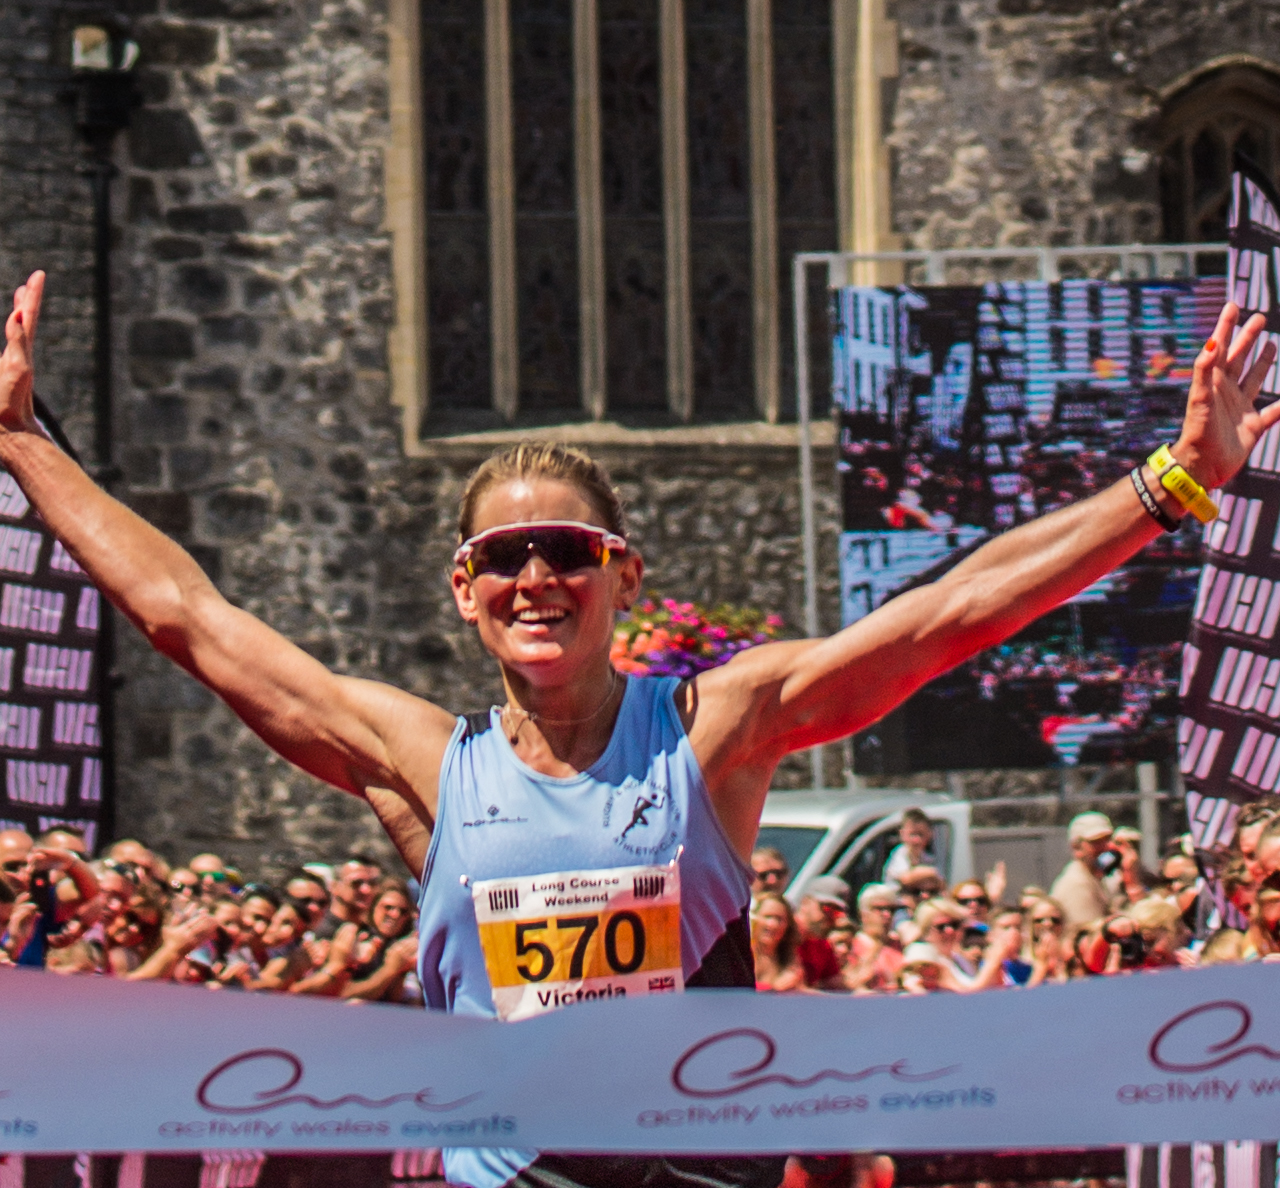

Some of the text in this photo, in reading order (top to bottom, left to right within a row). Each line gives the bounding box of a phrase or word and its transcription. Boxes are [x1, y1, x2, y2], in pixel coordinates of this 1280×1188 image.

[532, 876, 620, 893] Long Course
[544, 892, 609, 907] Weekend
[515, 909, 646, 982] 570
[537, 983, 627, 1006] Victoria
[1115, 1077, 1241, 1104] activity
[635, 1084, 997, 1128] activity wales events
[158, 1111, 518, 1138] activity wales events
